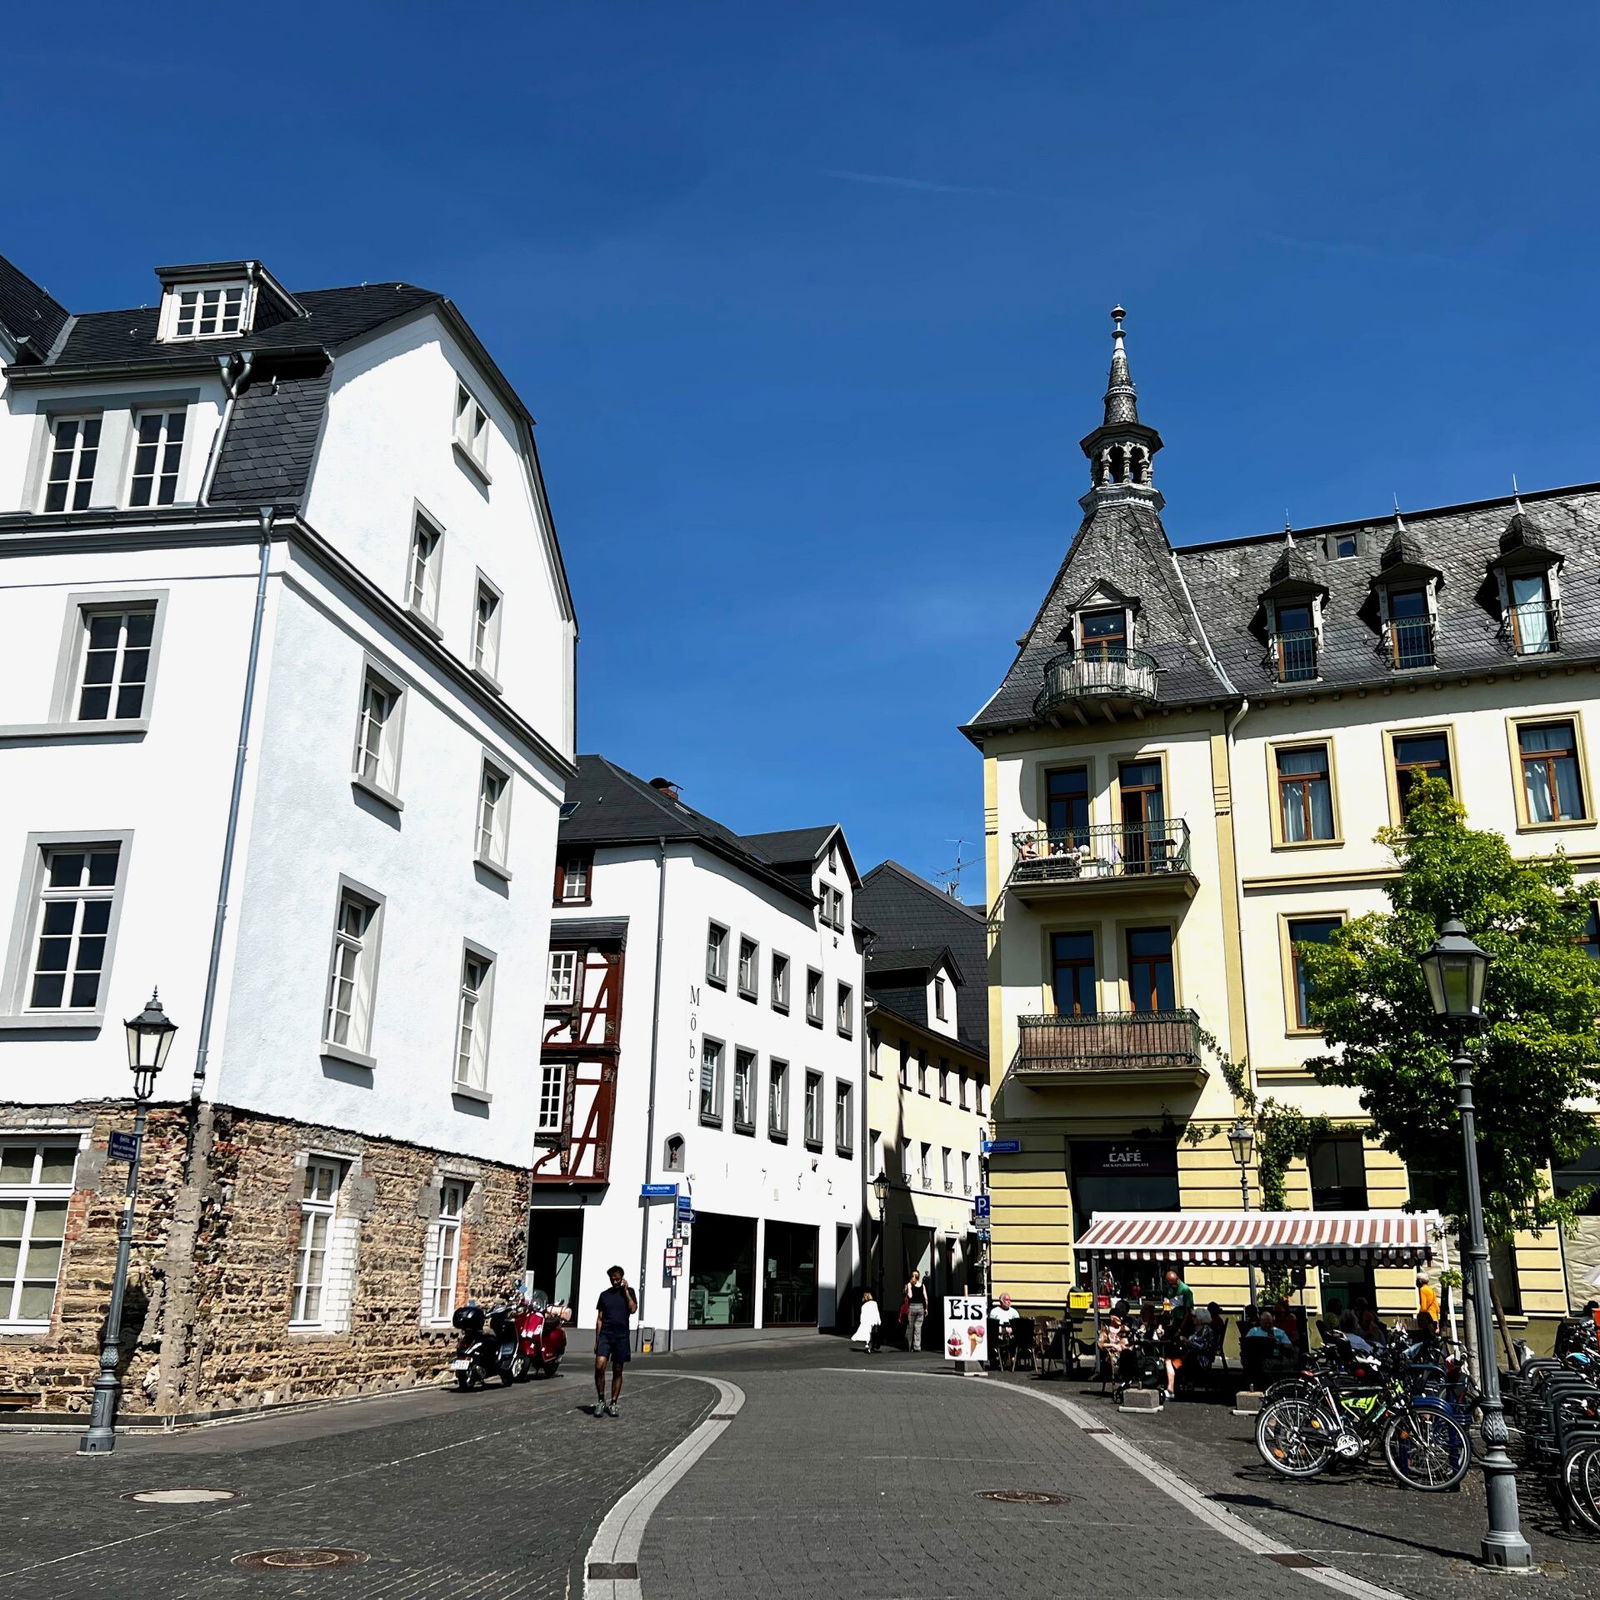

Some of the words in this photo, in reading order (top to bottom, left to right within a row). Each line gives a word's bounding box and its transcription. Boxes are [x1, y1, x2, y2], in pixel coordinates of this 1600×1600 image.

[688, 985, 700, 1110] Möbel
[1109, 1149, 1142, 1162] CAFÉ
[978, 1197, 987, 1214] P
[948, 1298, 983, 1321] Eis
